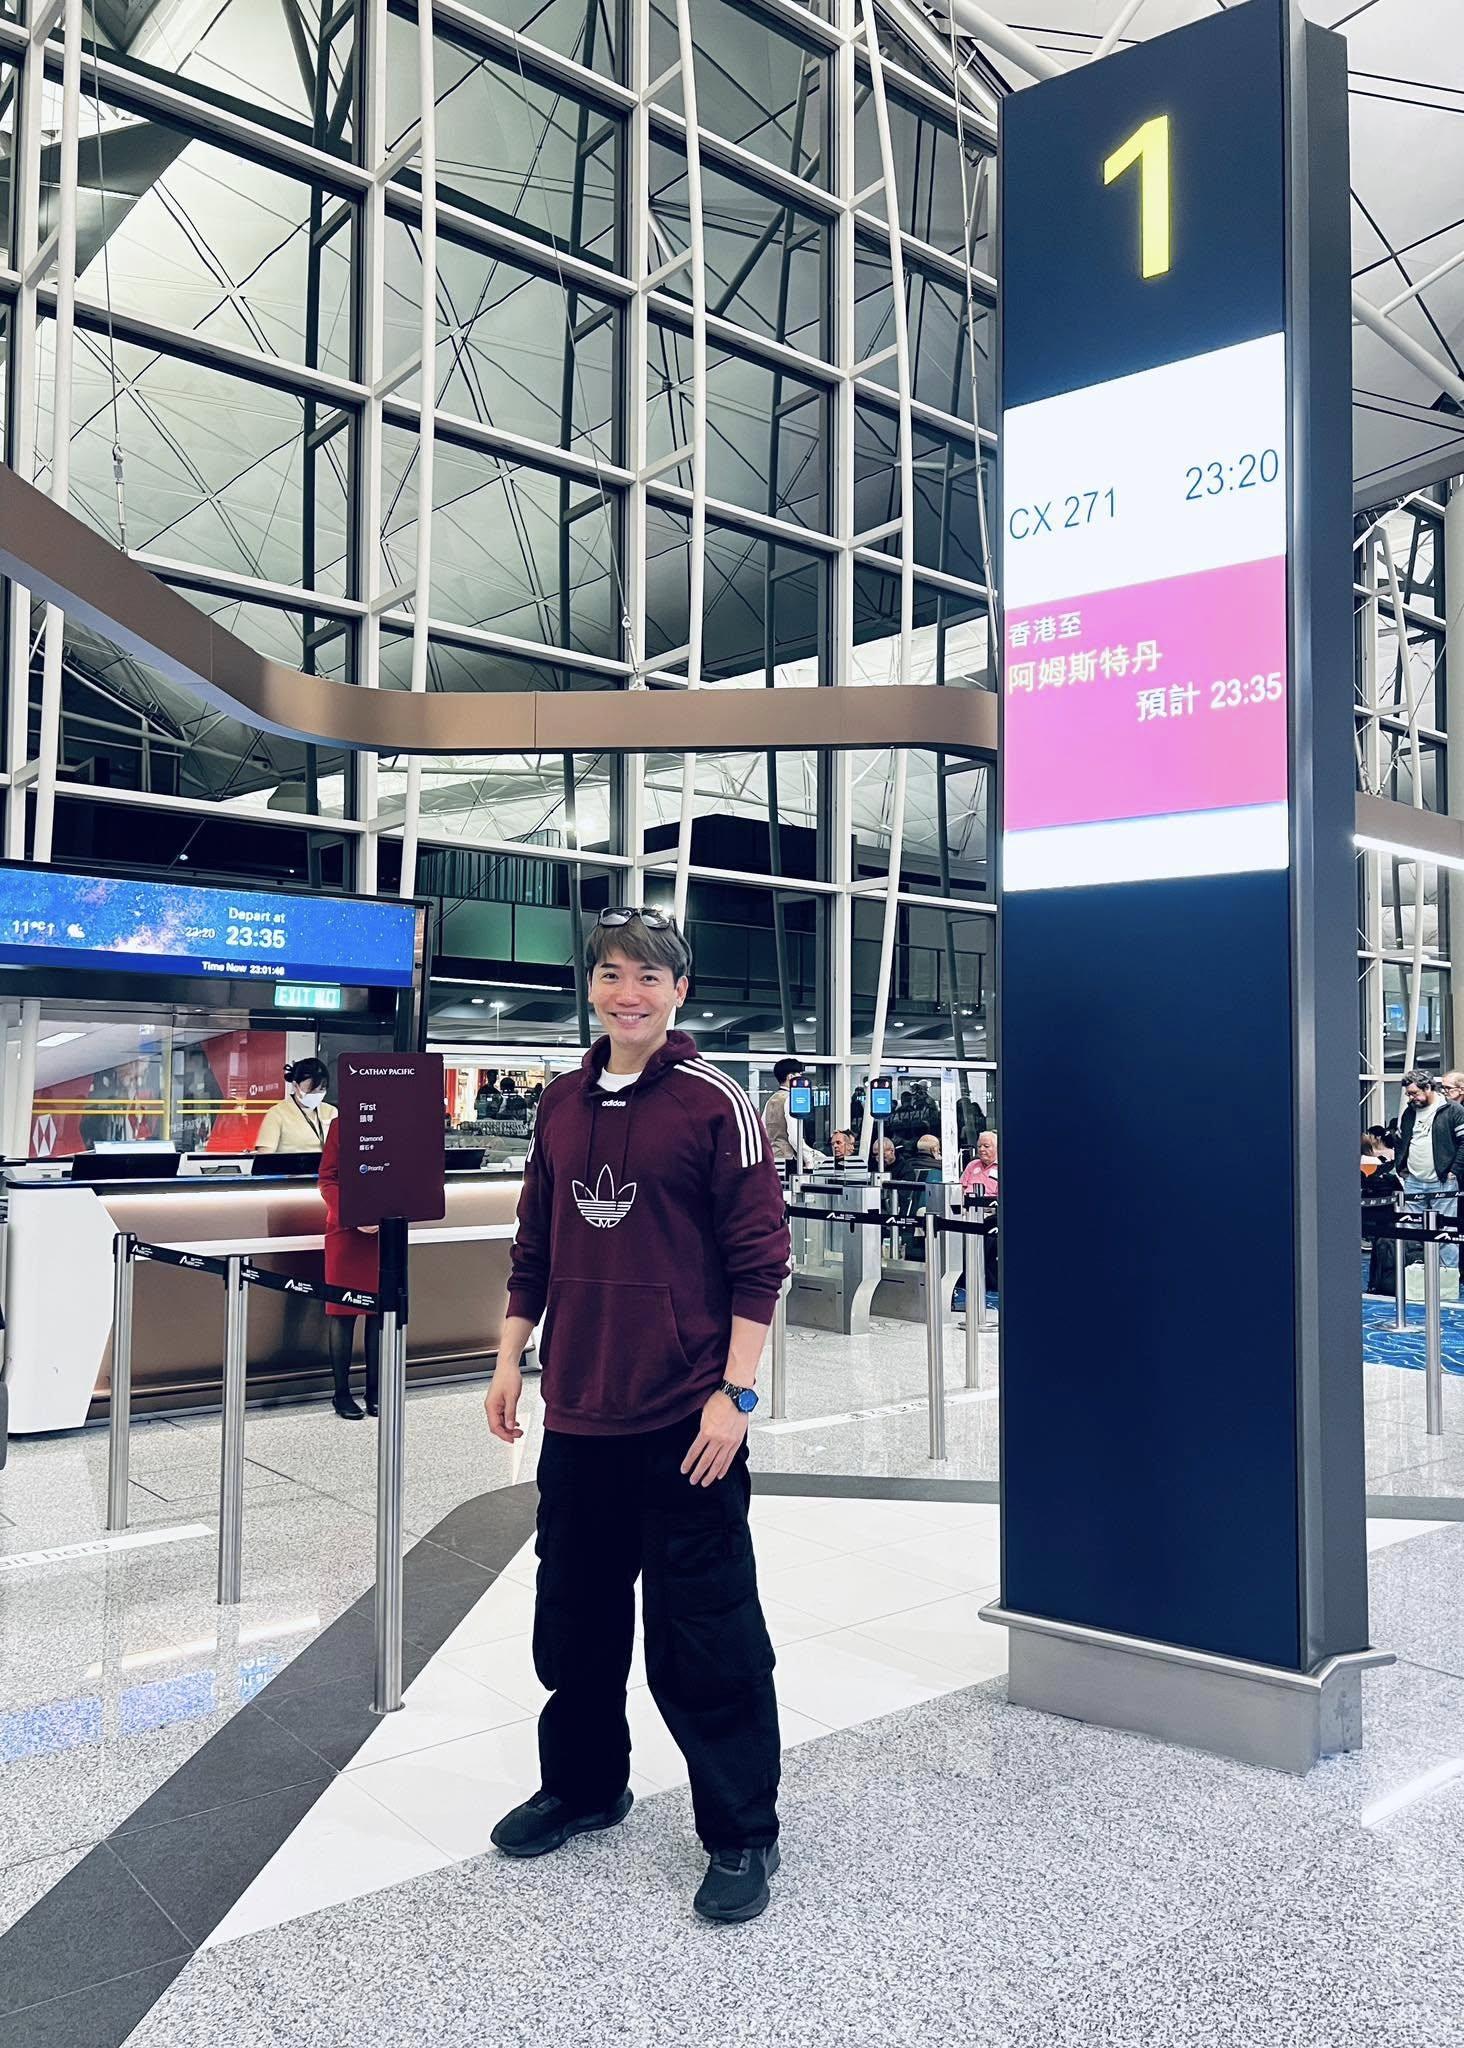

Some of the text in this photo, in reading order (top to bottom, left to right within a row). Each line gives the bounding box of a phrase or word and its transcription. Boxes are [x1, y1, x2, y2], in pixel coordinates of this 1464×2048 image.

[1103, 114, 1170, 279] 1
[1008, 448, 1279, 540] CX 271 23:20
[1007, 611, 1083, 649] 香港至
[1007, 639, 1164, 695] 阿姆斯特丹
[1135, 671, 1283, 723] 預計 23:35
[228, 906, 286, 924] Depart at
[225, 925, 286, 949] 23:35
[202, 960, 225, 972] Time
[226, 962, 247, 973] Now
[359, 1068, 415, 1076] CATHAY PACIFIC
[359, 1102, 377, 1111] First
[601, 1099, 627, 1107] adidas
[359, 1135, 384, 1143] Diamond
